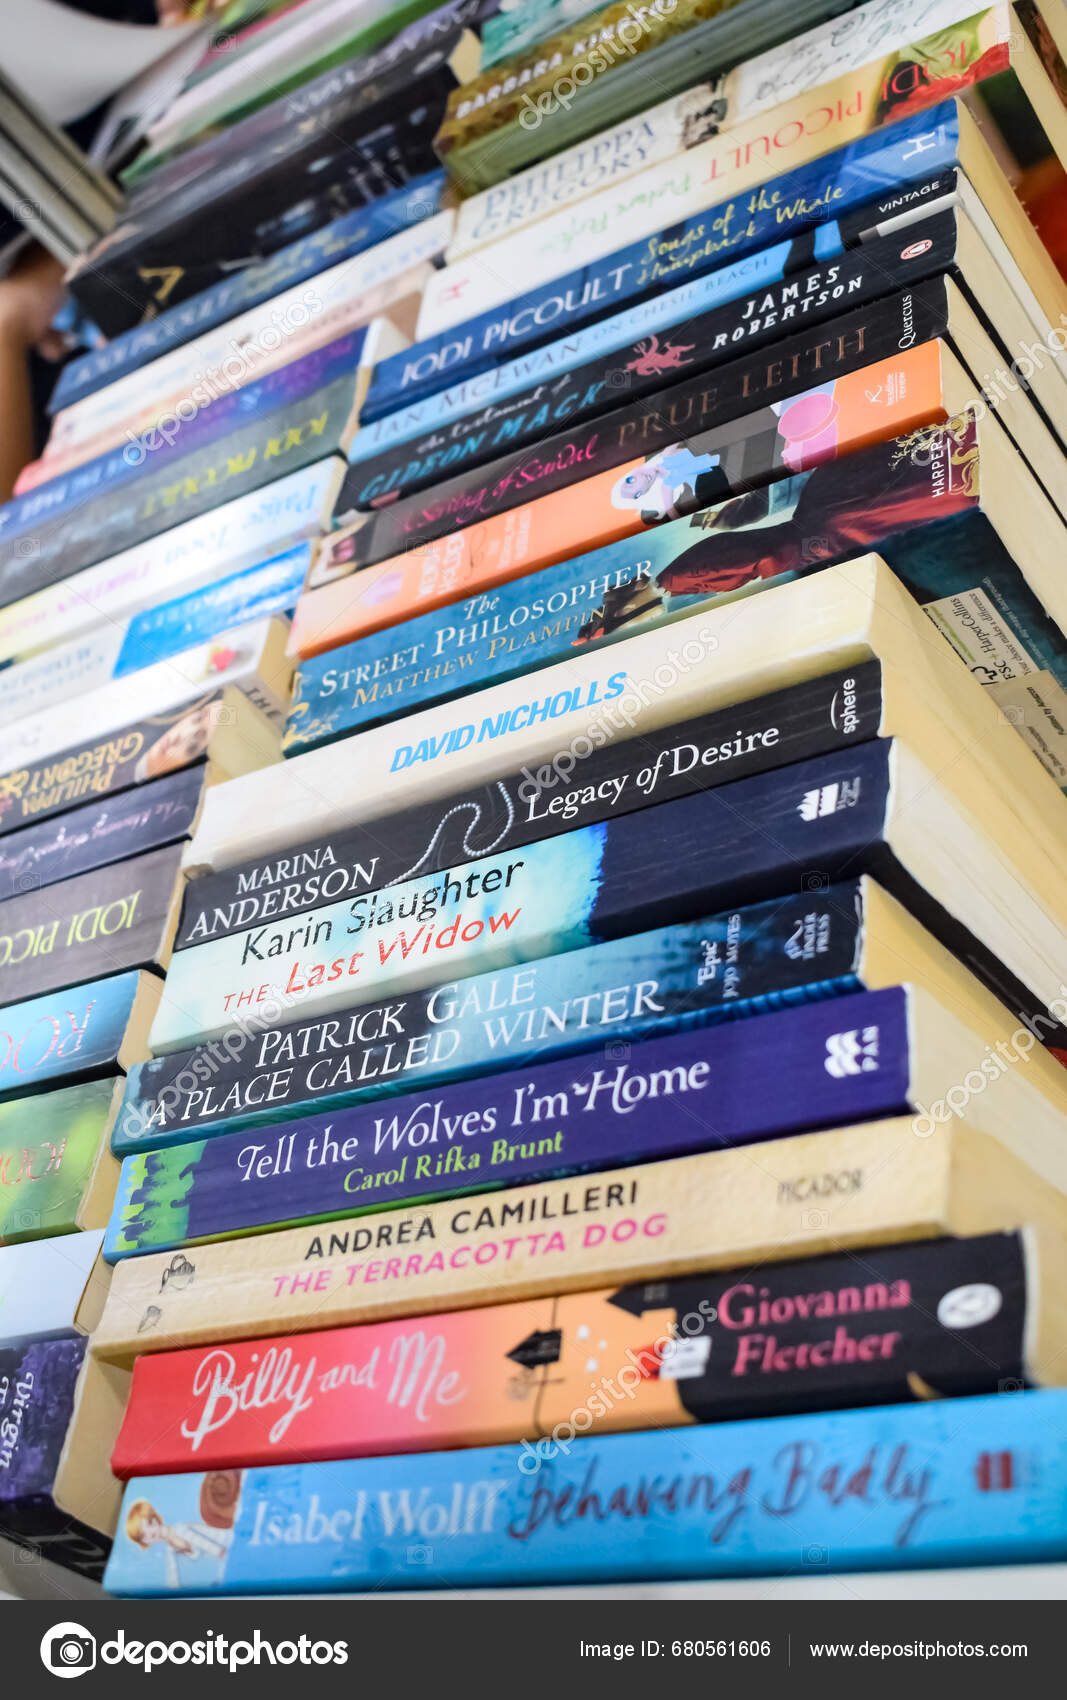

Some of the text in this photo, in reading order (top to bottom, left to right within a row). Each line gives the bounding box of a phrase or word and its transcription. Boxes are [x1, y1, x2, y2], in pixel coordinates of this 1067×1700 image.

[456, 52, 562, 118] BARBARA
[882, 40, 968, 102] JODI
[484, 120, 655, 218] PHILIPPA
[702, 90, 863, 185] PICOULT
[471, 146, 652, 240] GREGORY
[636, 184, 846, 284] Humpback Whale
[646, 188, 786, 263] Songs of the
[878, 180, 941, 214] VINTAGE
[399, 335, 474, 390] JODI
[482, 263, 633, 350] PICOULT
[712, 276, 863, 351] ROBERTSON
[741, 266, 841, 320] JAMES
[897, 294, 913, 350] Quercus
[373, 408, 422, 442] IAN
[594, 317, 619, 340] ON
[629, 290, 694, 327] CHESIL
[704, 258, 770, 293] BEACH
[616, 388, 719, 447] PRUE
[740, 326, 867, 399] LEITH
[359, 380, 606, 503] GIDEON MACK
[931, 434, 948, 499] HARPER
[319, 559, 653, 698] STREET PHILOSOPHER
[463, 594, 500, 621] The
[950, 596, 997, 655] HarperCollins
[351, 603, 608, 710] MATTHEW PLAMPIN
[993, 658, 1017, 682] FSC
[389, 671, 628, 773] DAVID NICHOLLS
[839, 678, 857, 735] sphere
[30, 731, 145, 795] GREGORY
[525, 727, 780, 822] Legacy of Desire
[186, 856, 381, 942] ANDERSON
[236, 844, 339, 896] MARINA
[67, 890, 142, 947] JODI
[241, 860, 526, 967] Karin Slaughter
[224, 907, 522, 1013] THE Last Widow
[144, 979, 665, 1129] A PLACE CALLED WINTER
[255, 968, 538, 1068] PATRICK GALE
[860, 1023, 879, 1074] PAN
[236, 1131, 299, 1183] Tell
[305, 1124, 360, 1169] the
[372, 1099, 498, 1156] Wolves
[570, 1059, 712, 1115] Home
[343, 1130, 565, 1194] Carol Rifka Brunt
[304, 1180, 640, 1262] ANDREA CAMILLERI
[777, 1166, 866, 1206] PICADOR
[272, 1212, 670, 1299] THE TERRACOTTA DOG
[717, 1278, 913, 1331] Giovanna
[180, 1330, 471, 1451] Billy and Me
[730, 1323, 901, 1377] Fletcher
[0, 1370, 35, 1470] Virgin
[247, 1439, 953, 1550] Isabel Wolff Behaving Badly
